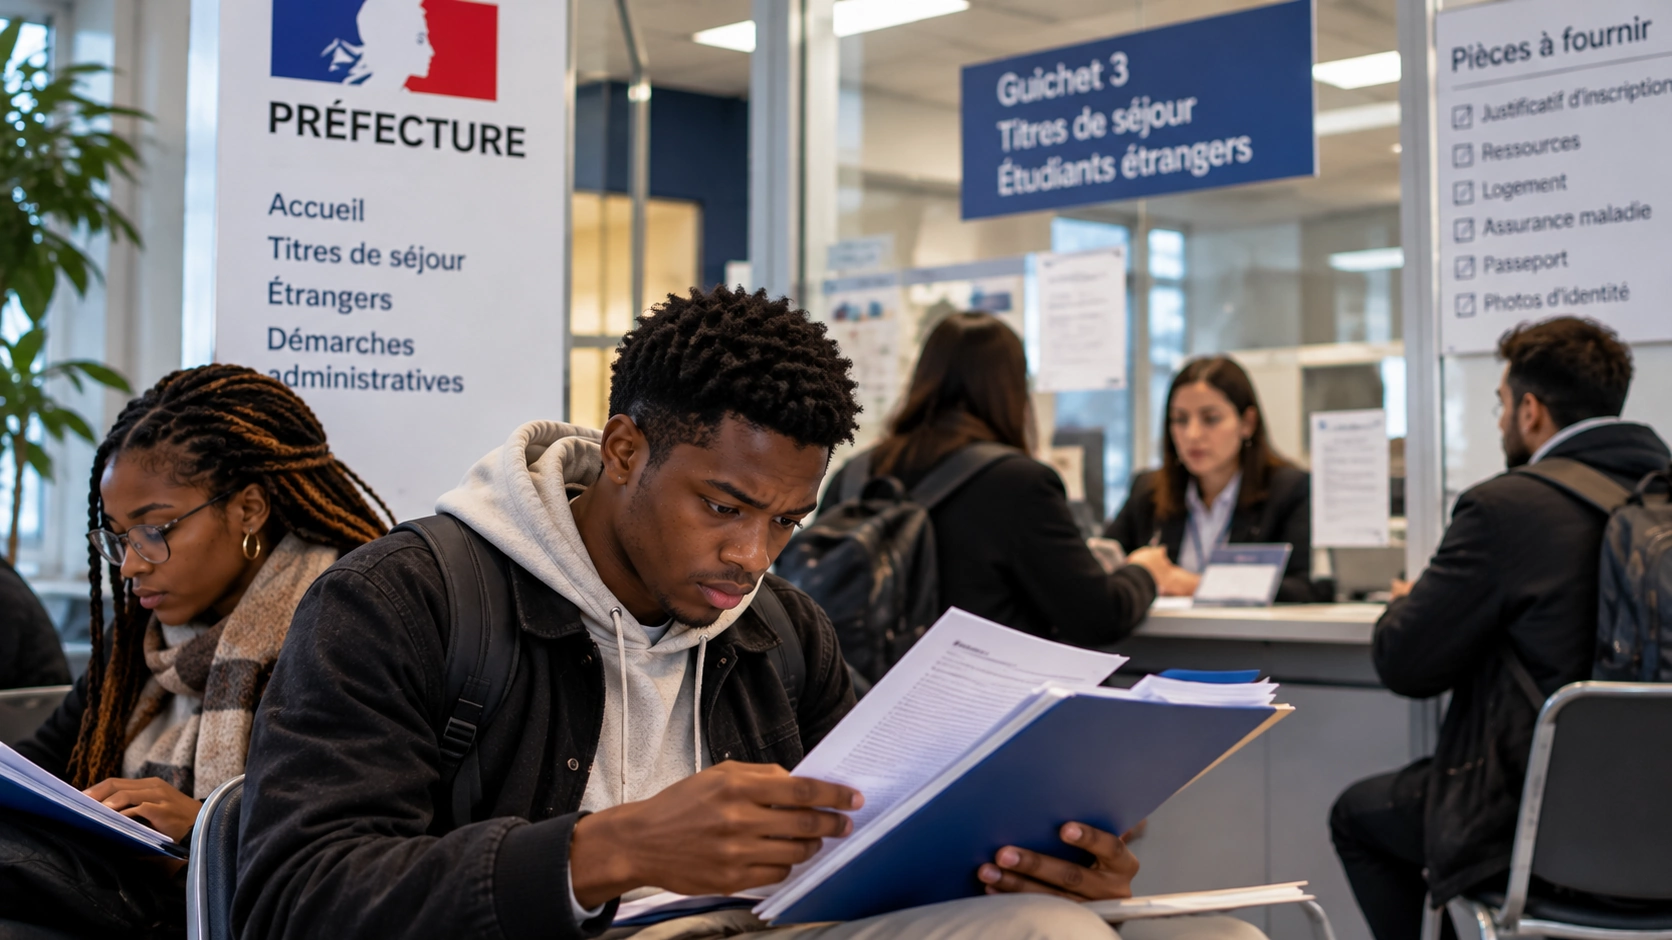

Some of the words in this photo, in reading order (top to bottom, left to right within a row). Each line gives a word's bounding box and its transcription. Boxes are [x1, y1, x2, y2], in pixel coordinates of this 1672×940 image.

[1451, 40, 1531, 73] Pièces
[1539, 31, 1554, 58] à
[1562, 16, 1653, 54] fournir
[997, 58, 1104, 107] Guichet
[1109, 51, 1129, 87] 3
[996, 117, 1069, 152] Titres
[1073, 106, 1106, 141] de
[1111, 96, 1197, 139] séjour
[1481, 91, 1564, 124] Justificatif
[269, 100, 526, 159] PRÉFECTURE
[1482, 134, 1581, 162] Ressources
[998, 152, 1115, 197] Étudiants
[1121, 135, 1253, 177] étrangers
[1482, 173, 1567, 201] Logement
[268, 193, 365, 222] Accueil
[1482, 209, 1574, 238] Assurance
[1579, 200, 1652, 226] maladie
[268, 236, 342, 264] Titres
[350, 243, 381, 266] de
[390, 246, 466, 275] séjour
[1483, 250, 1568, 276] Passeport
[268, 276, 393, 314] Étrangers
[1484, 291, 1543, 313] Photos
[1547, 282, 1630, 308] d'identité
[267, 327, 415, 356] Démarches
